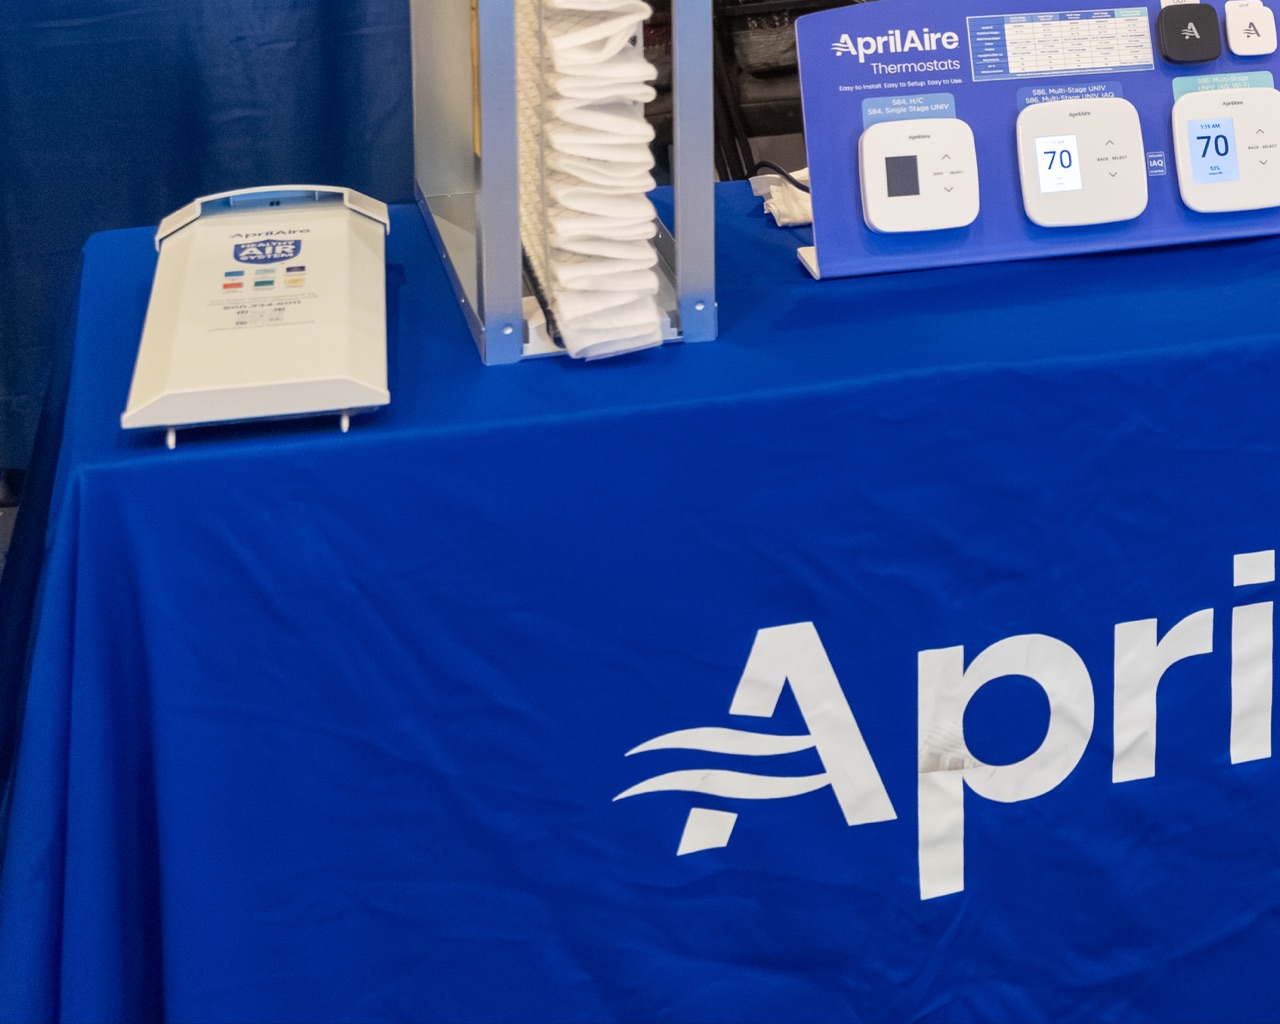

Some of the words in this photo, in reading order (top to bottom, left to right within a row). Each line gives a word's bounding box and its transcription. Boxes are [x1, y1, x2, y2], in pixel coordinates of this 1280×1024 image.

[830, 27, 960, 63] AprilAire
[870, 58, 961, 75] Thermostats
[884, 81, 899, 89] Easy
[907, 79, 926, 88] Setup.
[927, 78, 942, 87] Easy
[950, 77, 963, 85] Use.
[1048, 86, 1087, 95] Multi-Stage
[1088, 84, 1106, 92] UNIV
[909, 97, 925, 105] H/C
[885, 105, 907, 114] Single
[908, 104, 930, 113] Stage
[930, 102, 950, 111] UNIV
[1196, 134, 1230, 158] 70
[1043, 149, 1073, 170] 70
[1149, 159, 1164, 168] IAQ
[238, 244, 296, 257] AIR
[239, 253, 294, 261] SYSTEM
